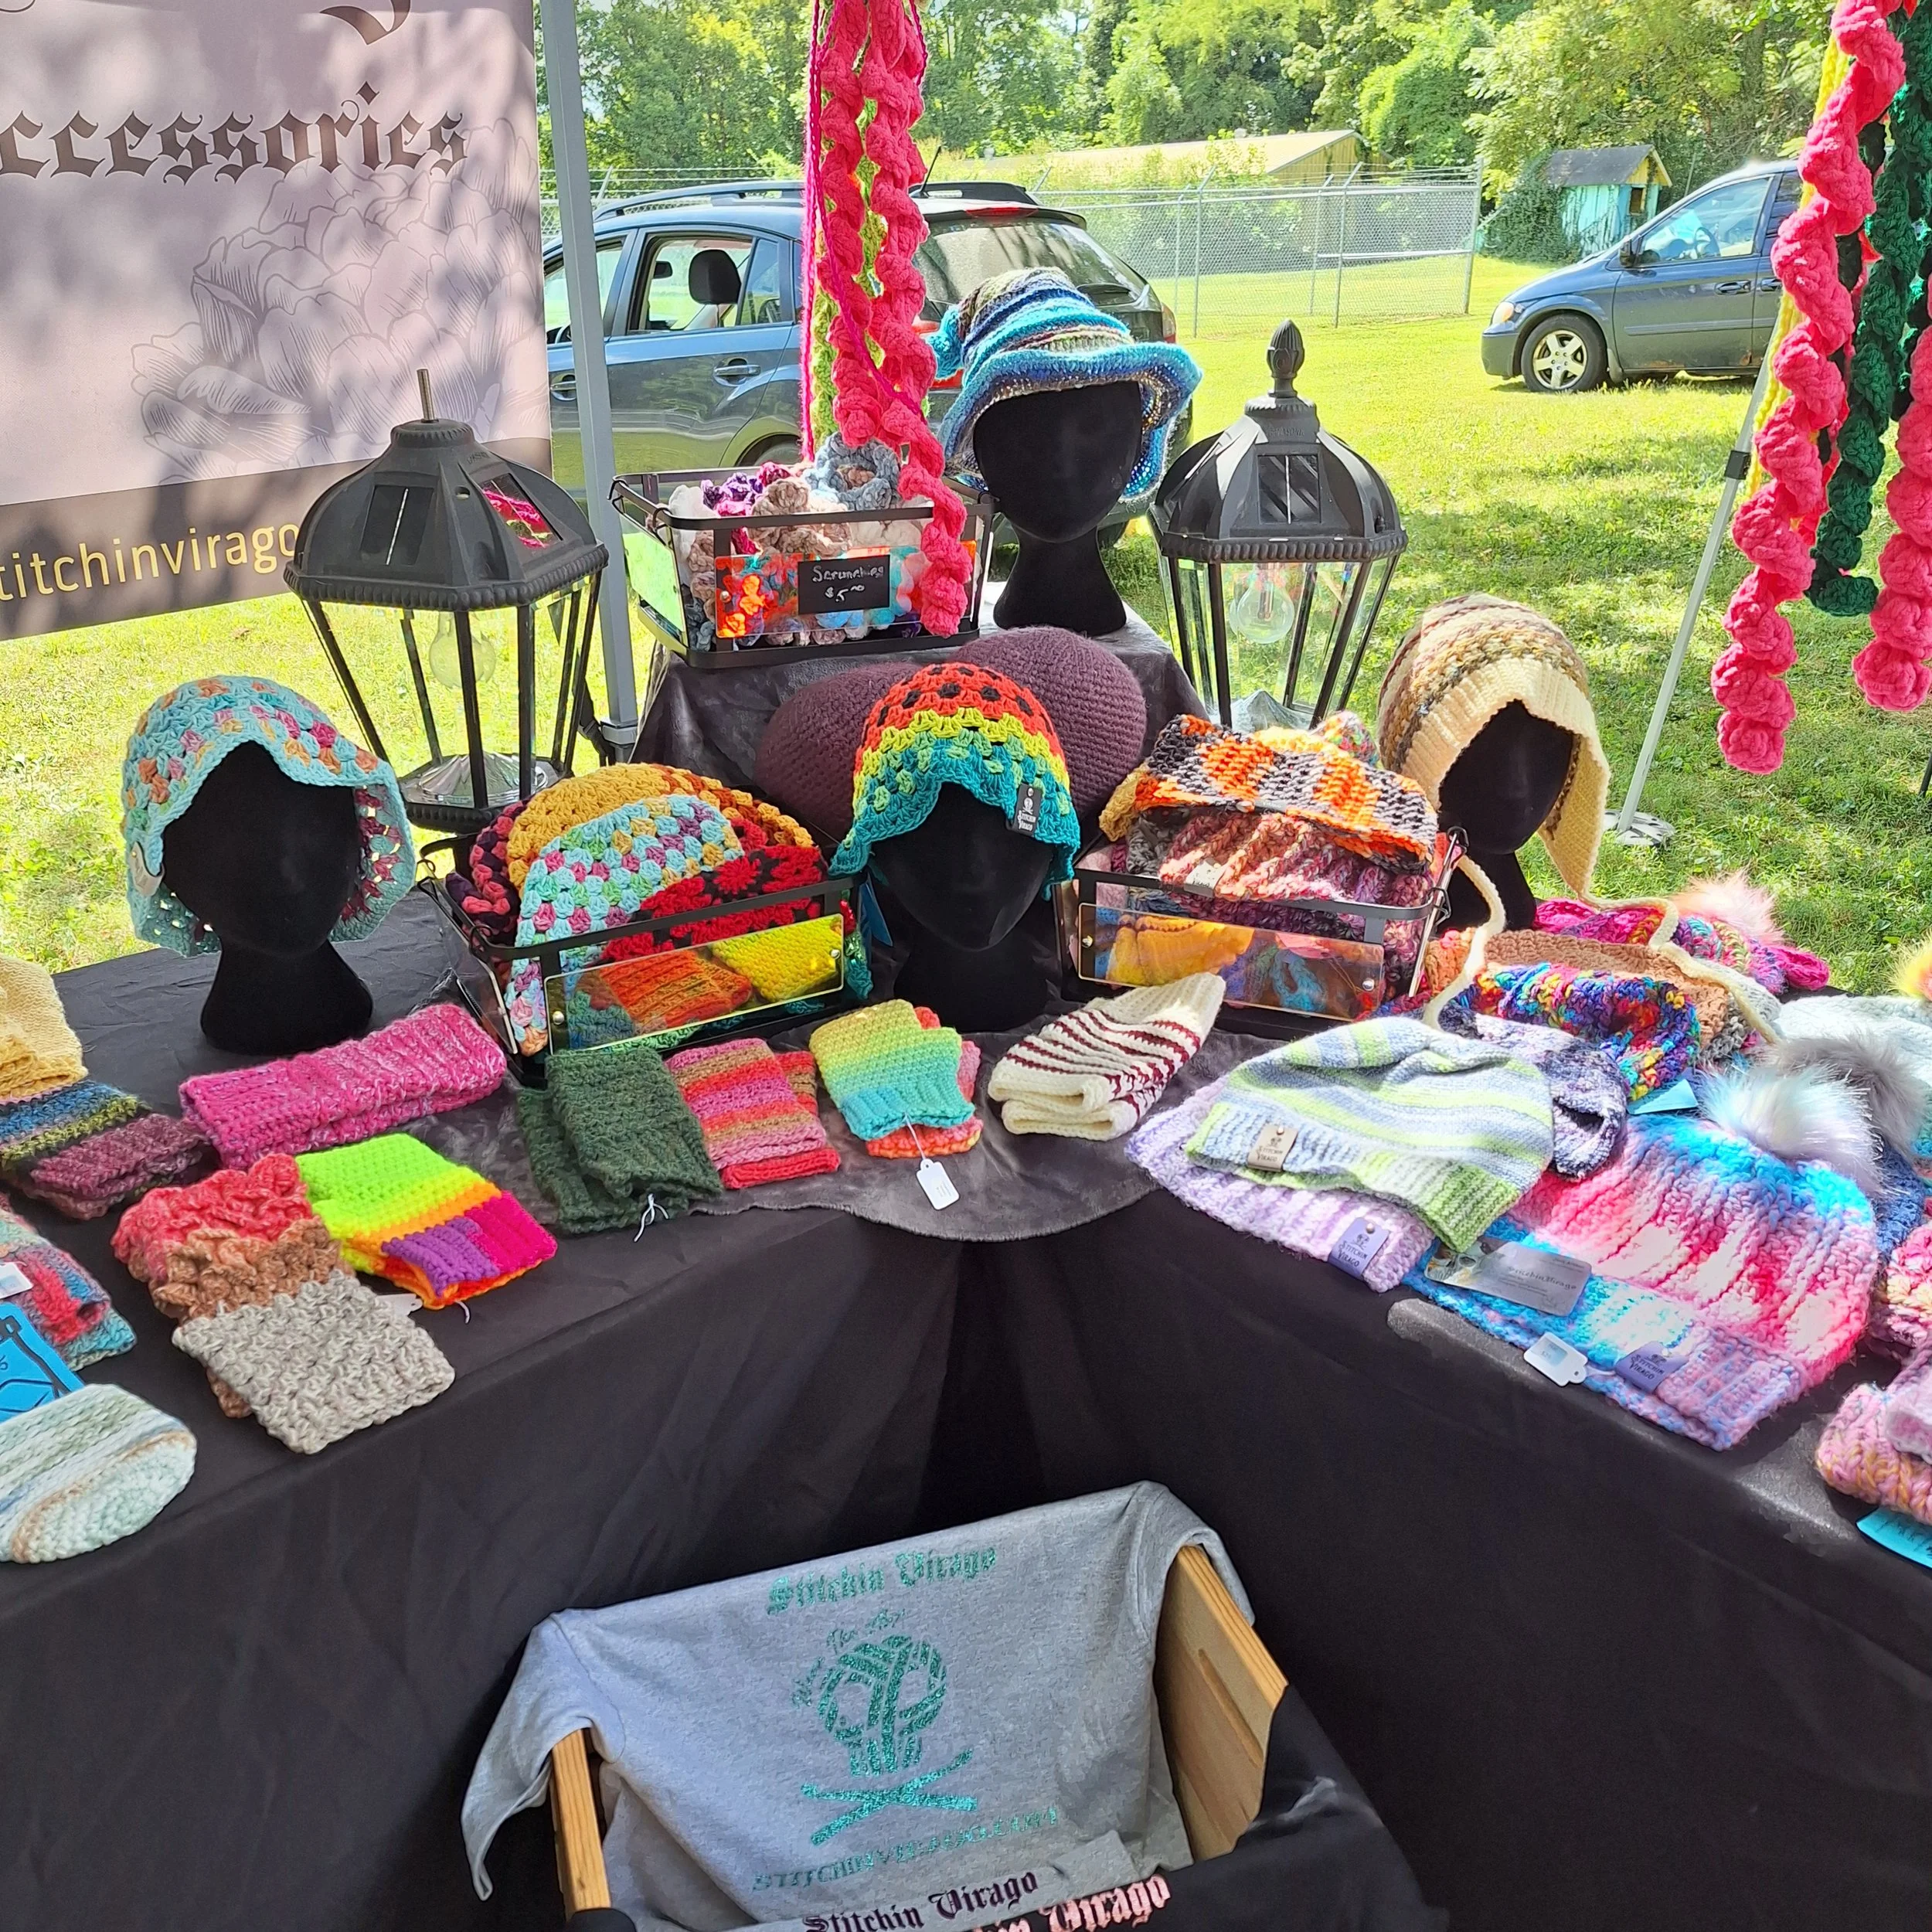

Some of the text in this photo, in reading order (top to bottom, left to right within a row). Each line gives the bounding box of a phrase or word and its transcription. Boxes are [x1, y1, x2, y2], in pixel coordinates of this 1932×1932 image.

[767, 1547, 996, 1615] Stitchin Virago
[928, 1871, 1039, 1920] Virago
[1039, 1872, 1172, 1932] Virago
